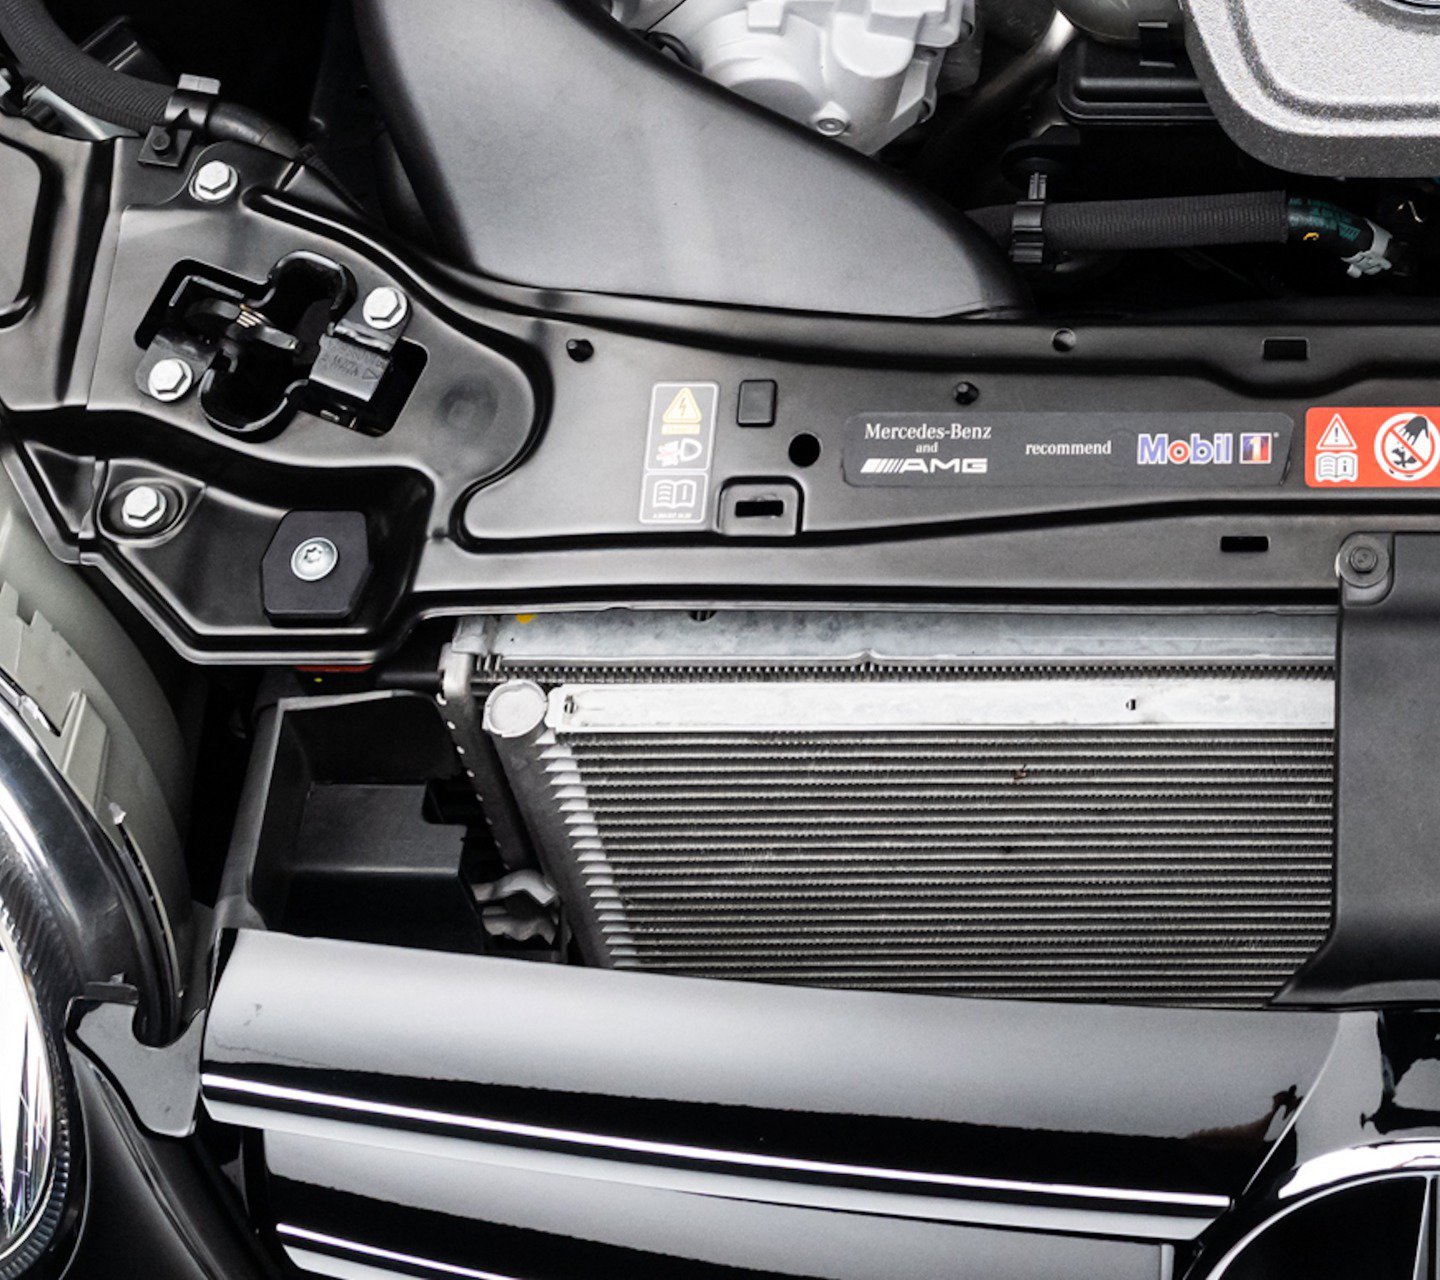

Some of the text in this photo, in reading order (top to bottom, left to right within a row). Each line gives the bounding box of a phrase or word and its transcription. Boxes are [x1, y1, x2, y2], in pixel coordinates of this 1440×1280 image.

[865, 423, 991, 440] Mercedes-Benz
[916, 442, 938, 454] and
[1025, 441, 1112, 455] recommend
[1137, 432, 1269, 465] Mobil 1
[899, 458, 988, 474] AMG
